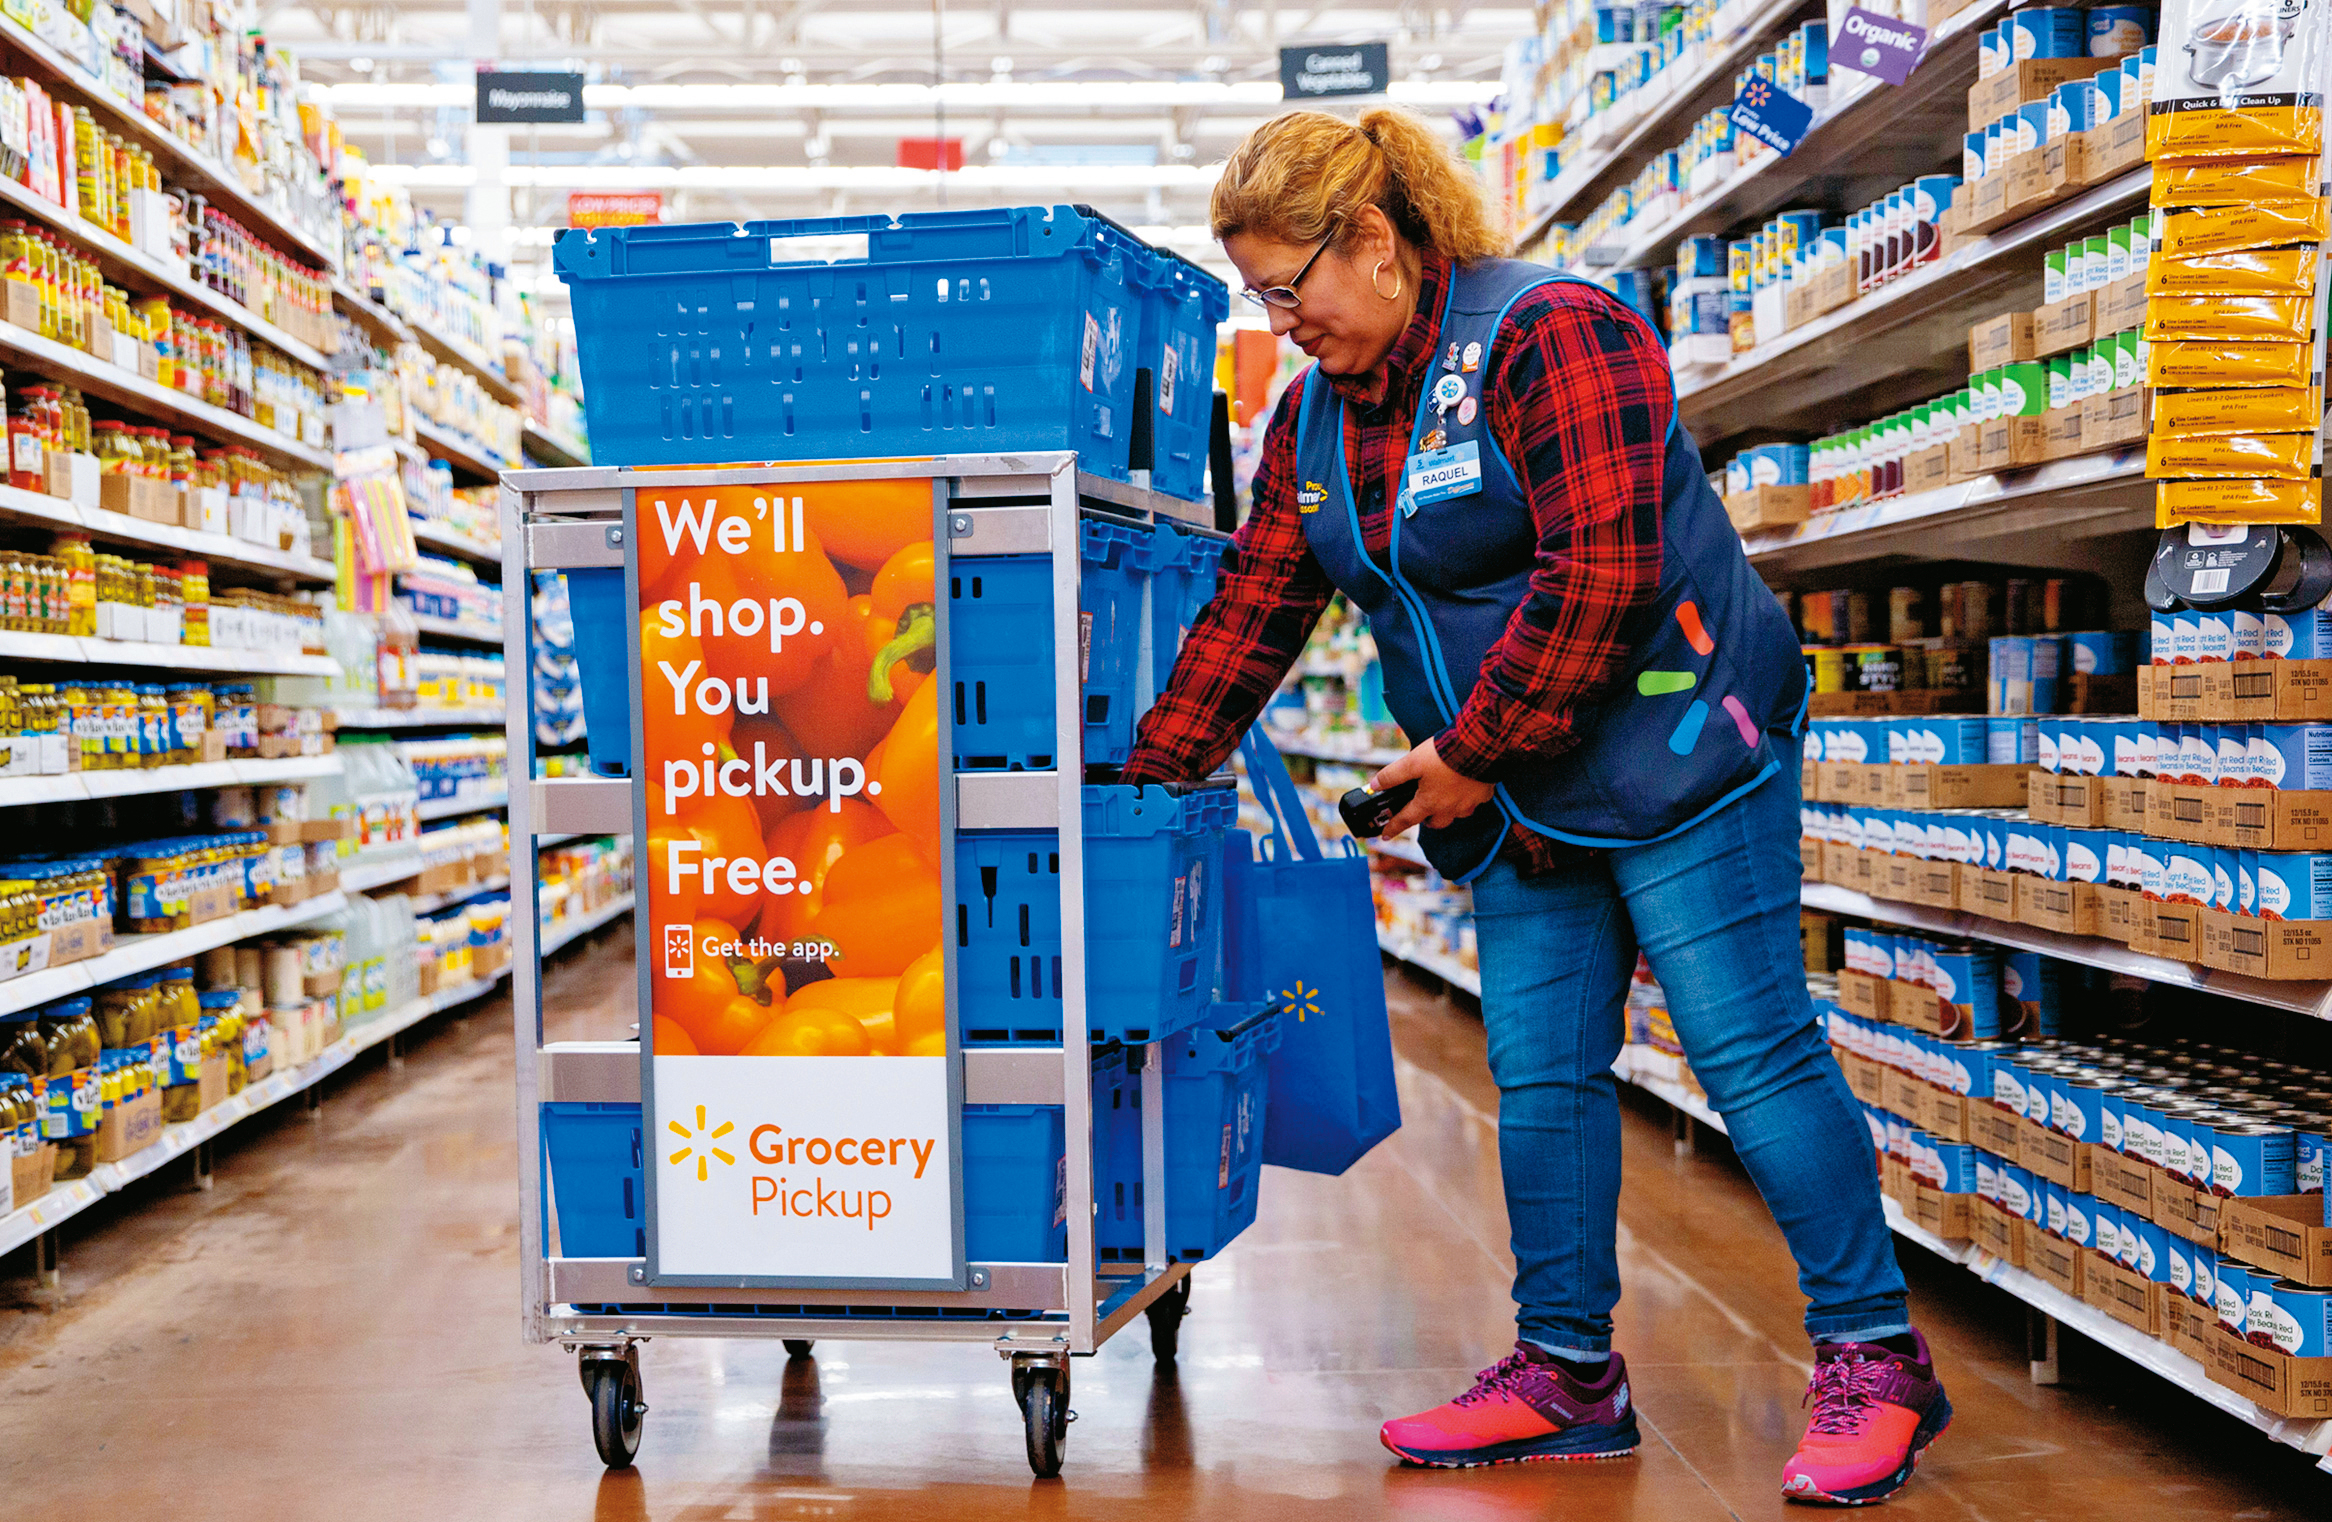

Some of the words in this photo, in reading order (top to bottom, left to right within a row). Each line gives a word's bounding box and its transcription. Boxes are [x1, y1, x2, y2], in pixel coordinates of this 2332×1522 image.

[1845, 15, 1917, 52] Organic
[2183, 100, 2208, 110] Quick
[2240, 96, 2265, 104] Clean
[2268, 95, 2281, 105] Up
[1731, 107, 1760, 133] Low
[1757, 125, 1790, 151] Price
[2167, 184, 2173, 194] 6
[2177, 236, 2183, 246] 6
[2161, 275, 2167, 284] 6
[2159, 320, 2165, 329] 6
[2160, 365, 2167, 374] 6
[2169, 418, 2175, 427] 6
[2161, 457, 2167, 466] 6
[1422, 467, 1468, 486] RAQUEL
[2170, 506, 2176, 515] 6
[655, 497, 804, 556] We'll
[658, 582, 824, 653] shop.
[2243, 629, 2258, 637] Red
[2271, 629, 2283, 637] Red
[2182, 635, 2195, 643] Red
[658, 660, 769, 715] You
[2229, 756, 2244, 764] Red
[2223, 765, 2244, 773] Beans
[664, 740, 882, 815] pickup.
[2291, 809, 2311, 817] 12/15.5
[668, 840, 813, 895] Free.
[2266, 886, 2279, 895] Red
[2283, 929, 2304, 937] 12/15.5
[702, 937, 734, 957] Get
[749, 937, 786, 957] the
[792, 939, 840, 962] app.
[749, 1123, 935, 1179] Grocery
[2220, 1164, 2232, 1173] Red
[2310, 1165, 2323, 1173] Da
[752, 1176, 892, 1231] Pickup
[2223, 1299, 2235, 1308] Red
[2249, 1308, 2263, 1317] Dark
[2279, 1324, 2293, 1333] Red
